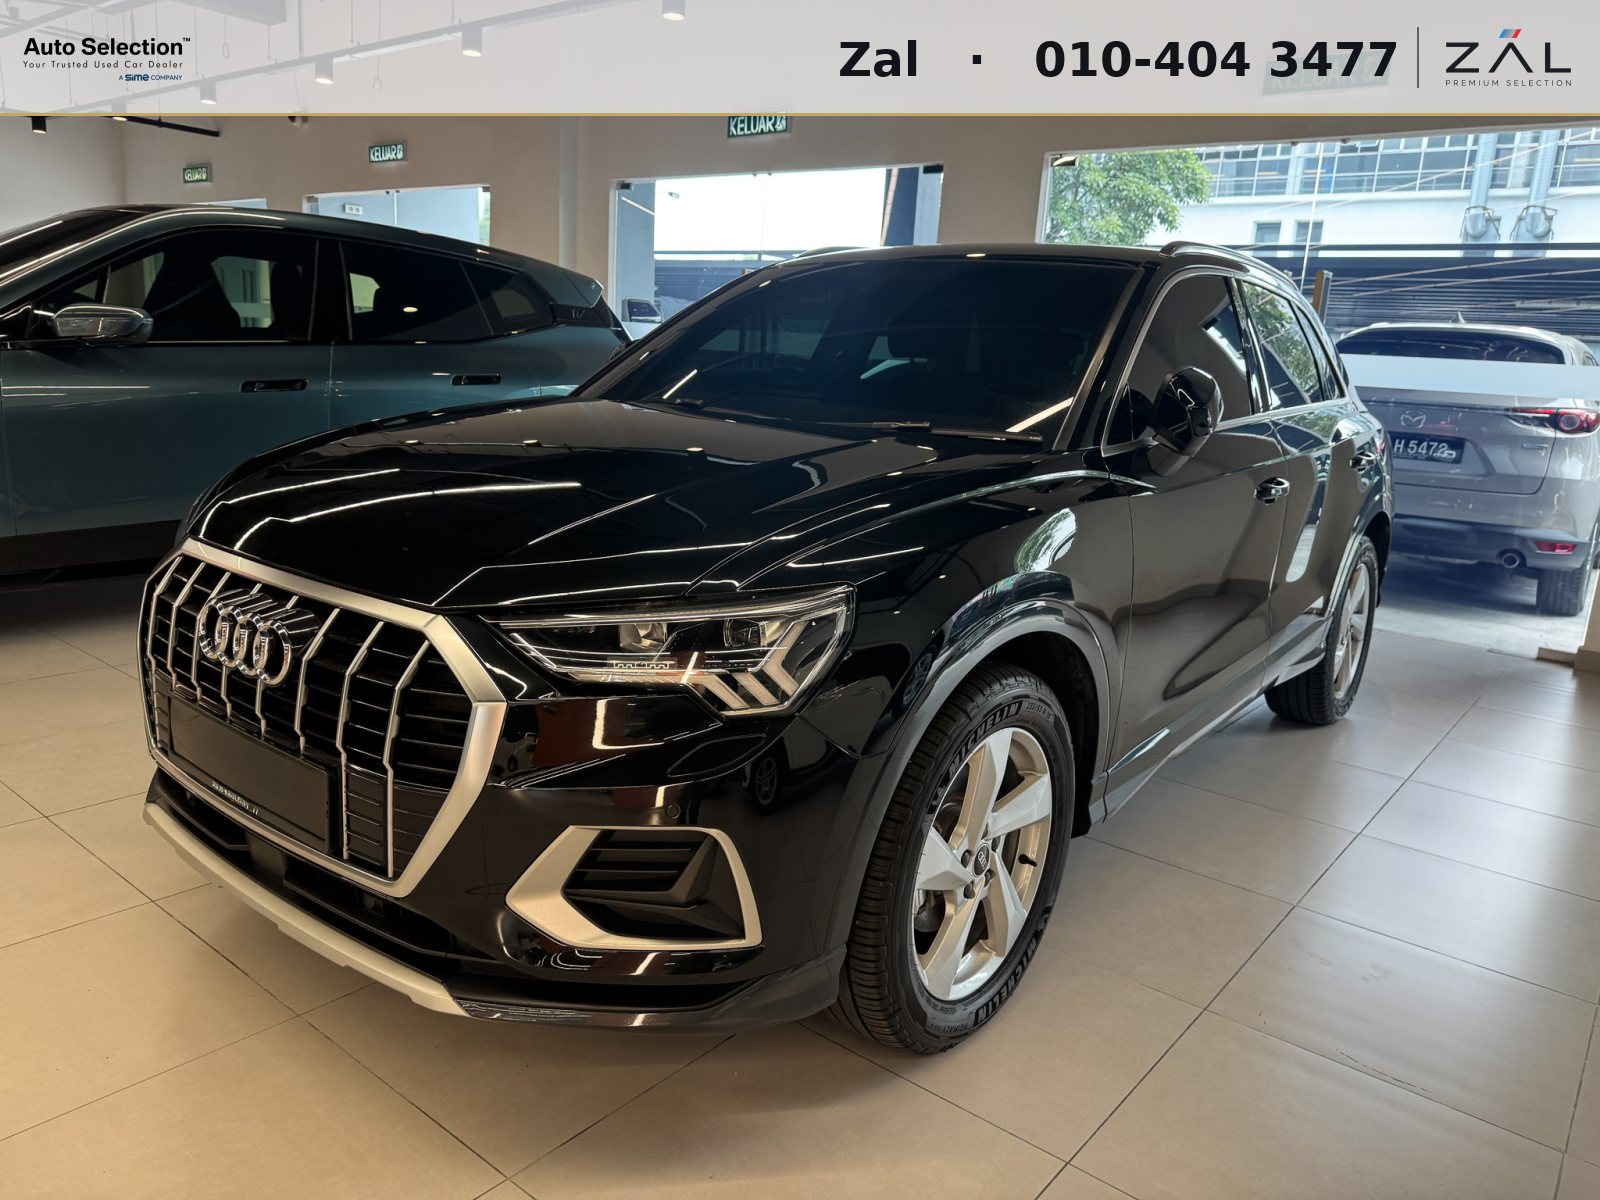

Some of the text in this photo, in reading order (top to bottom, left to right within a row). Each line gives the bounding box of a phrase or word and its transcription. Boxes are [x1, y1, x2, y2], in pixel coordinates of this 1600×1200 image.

[729, 115, 775, 136] KELUAR
[370, 145, 397, 161] KELUAR
[1408, 440, 1448, 457] 5472
[949, 702, 1020, 779] MICHELIN
[977, 937, 1038, 1023] MICHELIN
